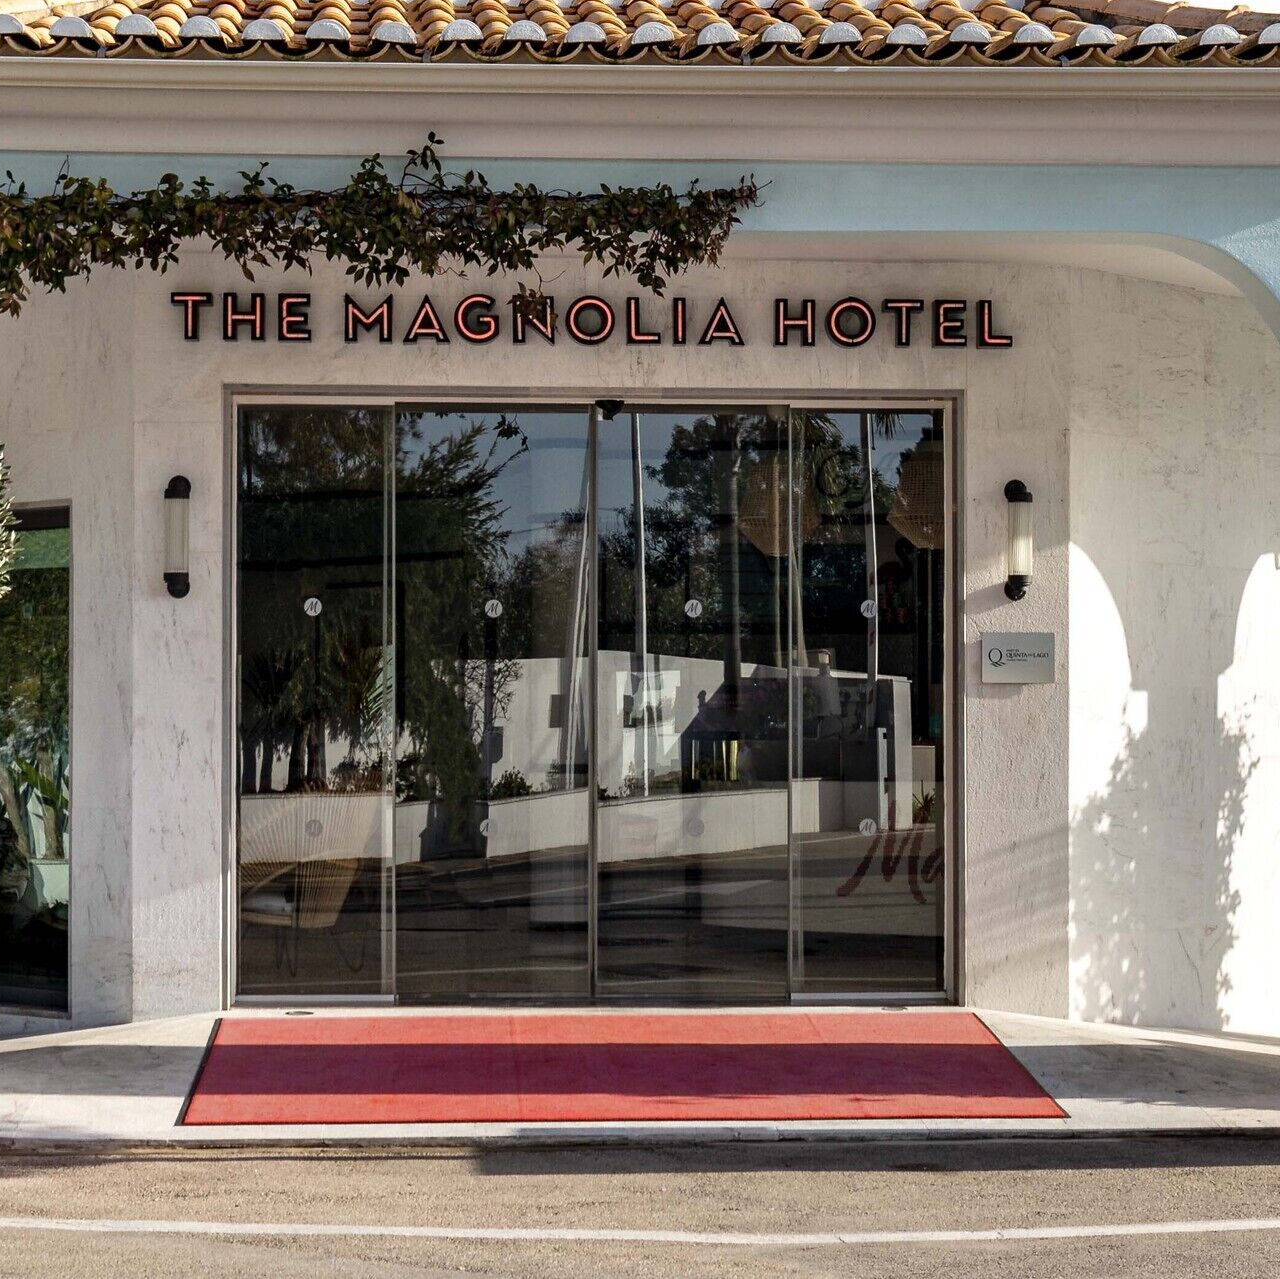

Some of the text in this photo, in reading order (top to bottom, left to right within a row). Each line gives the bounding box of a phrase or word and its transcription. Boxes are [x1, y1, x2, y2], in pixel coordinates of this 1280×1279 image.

[171, 292, 1013, 348] THE MAGNOLIA HOTEL
